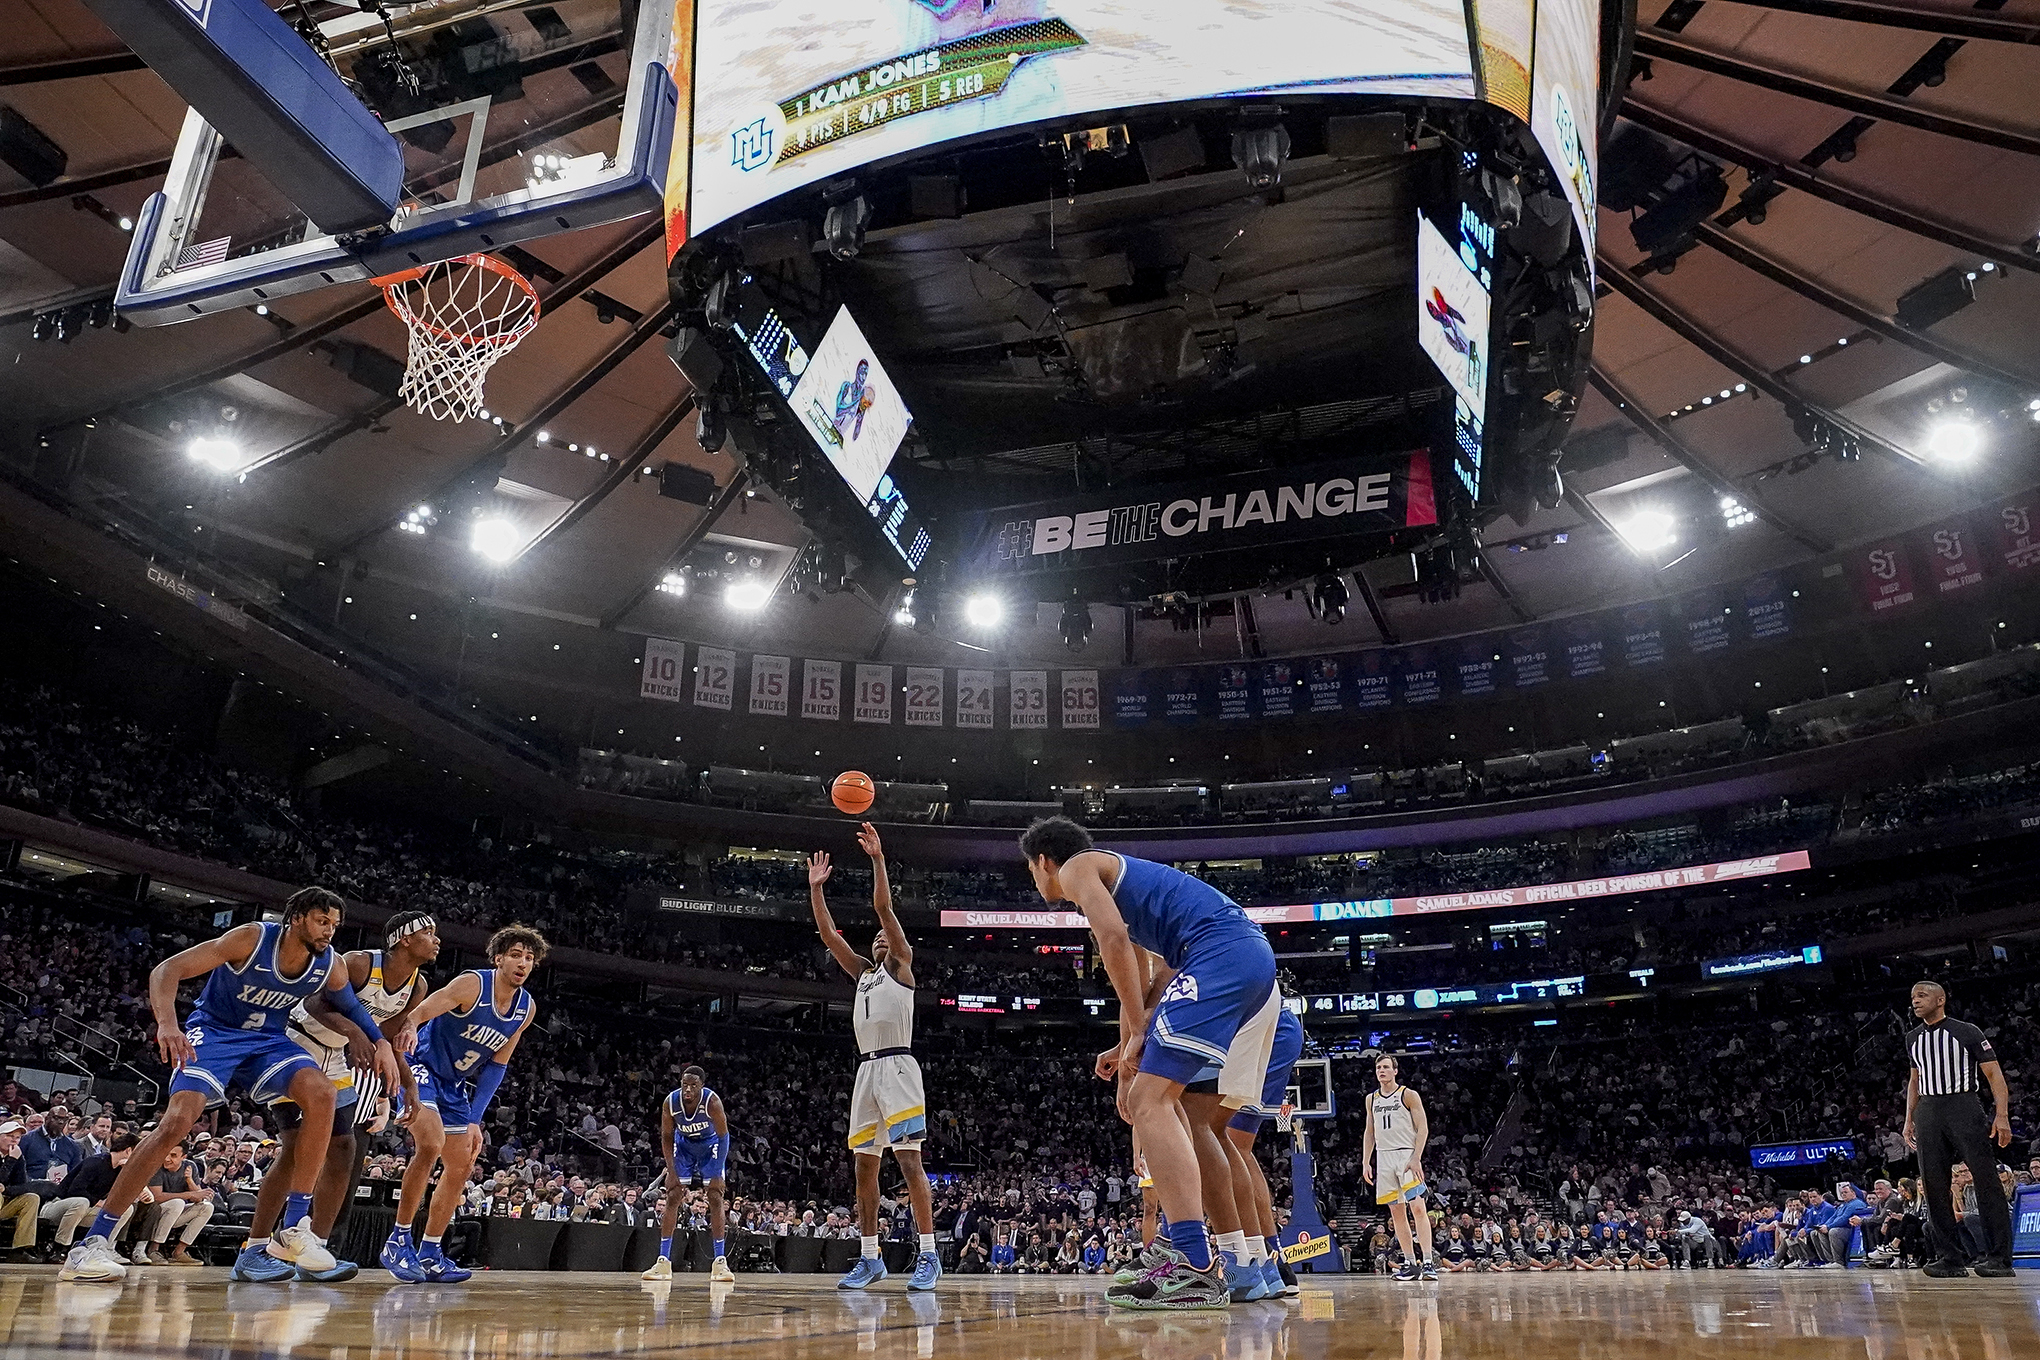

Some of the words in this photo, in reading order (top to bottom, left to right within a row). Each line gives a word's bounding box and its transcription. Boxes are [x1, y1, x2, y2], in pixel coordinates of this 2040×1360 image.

[796, 101, 804, 118] 1
[810, 76, 860, 112] KAM
[865, 51, 941, 91] JONES
[811, 121, 834, 145] PTS
[859, 98, 889, 125] 4/9
[893, 92, 911, 116] FG
[940, 80, 951, 102] 5
[956, 72, 984, 98] REB
[147, 567, 196, 603] CHASE
[650, 656, 677, 682] 10
[702, 665, 729, 690] 12
[757, 672, 784, 697] 15
[1357, 676, 1388, 687] 1970-71
[643, 682, 679, 698] KNICKS
[809, 678, 836, 701] 15
[860, 682, 887, 705] 19
[907, 685, 941, 708] 22
[1262, 686, 1293, 697] 1951-52
[696, 691, 731, 706] KNICKS
[751, 699, 787, 712] KNICKS
[959, 687, 991, 710] 24
[1012, 688, 1046, 711] 33
[1061, 687, 1099, 710] 613
[804, 703, 839, 716] KNICKS
[855, 707, 890, 720] KNICKS
[906, 709, 942, 722] KNICKS
[958, 713, 993, 726] KNICKS
[1012, 713, 1047, 726] KNICKS
[1064, 713, 1099, 725] KNICKS
[1417, 897, 1467, 912] SAMUEL
[1467, 891, 1514, 906] ADAMS
[1525, 885, 1576, 902] OFFICIAL
[1577, 880, 1608, 896] BEER
[1609, 873, 1663, 893] SPONSOR
[1664, 871, 1681, 886] OF
[1681, 867, 1706, 883] THE
[661, 899, 683, 910] BUD
[684, 901, 715, 912] LIGHT
[716, 903, 744, 914] BLUE
[744, 905, 777, 916] SEATS
[967, 913, 1012, 926] SAMUEL
[1014, 913, 1056, 926] ADAMS
[1639, 976, 1647, 987] 1
[1537, 987, 1547, 997] 2
[864, 995, 871, 1020] 1
[940, 998, 956, 1006] 7:54
[1314, 998, 1334, 1010] 46
[1343, 999, 1377, 1011] 15:23
[1386, 994, 1405, 1007] 26
[1090, 1005, 1099, 1016] 3
[241, 1012, 267, 1031] 2
[454, 1050, 481, 1072] 3
[1383, 1114, 1392, 1130] 11
[1758, 1151, 1796, 1165] Michelob
[1283, 1240, 1328, 1262] Schweppes
